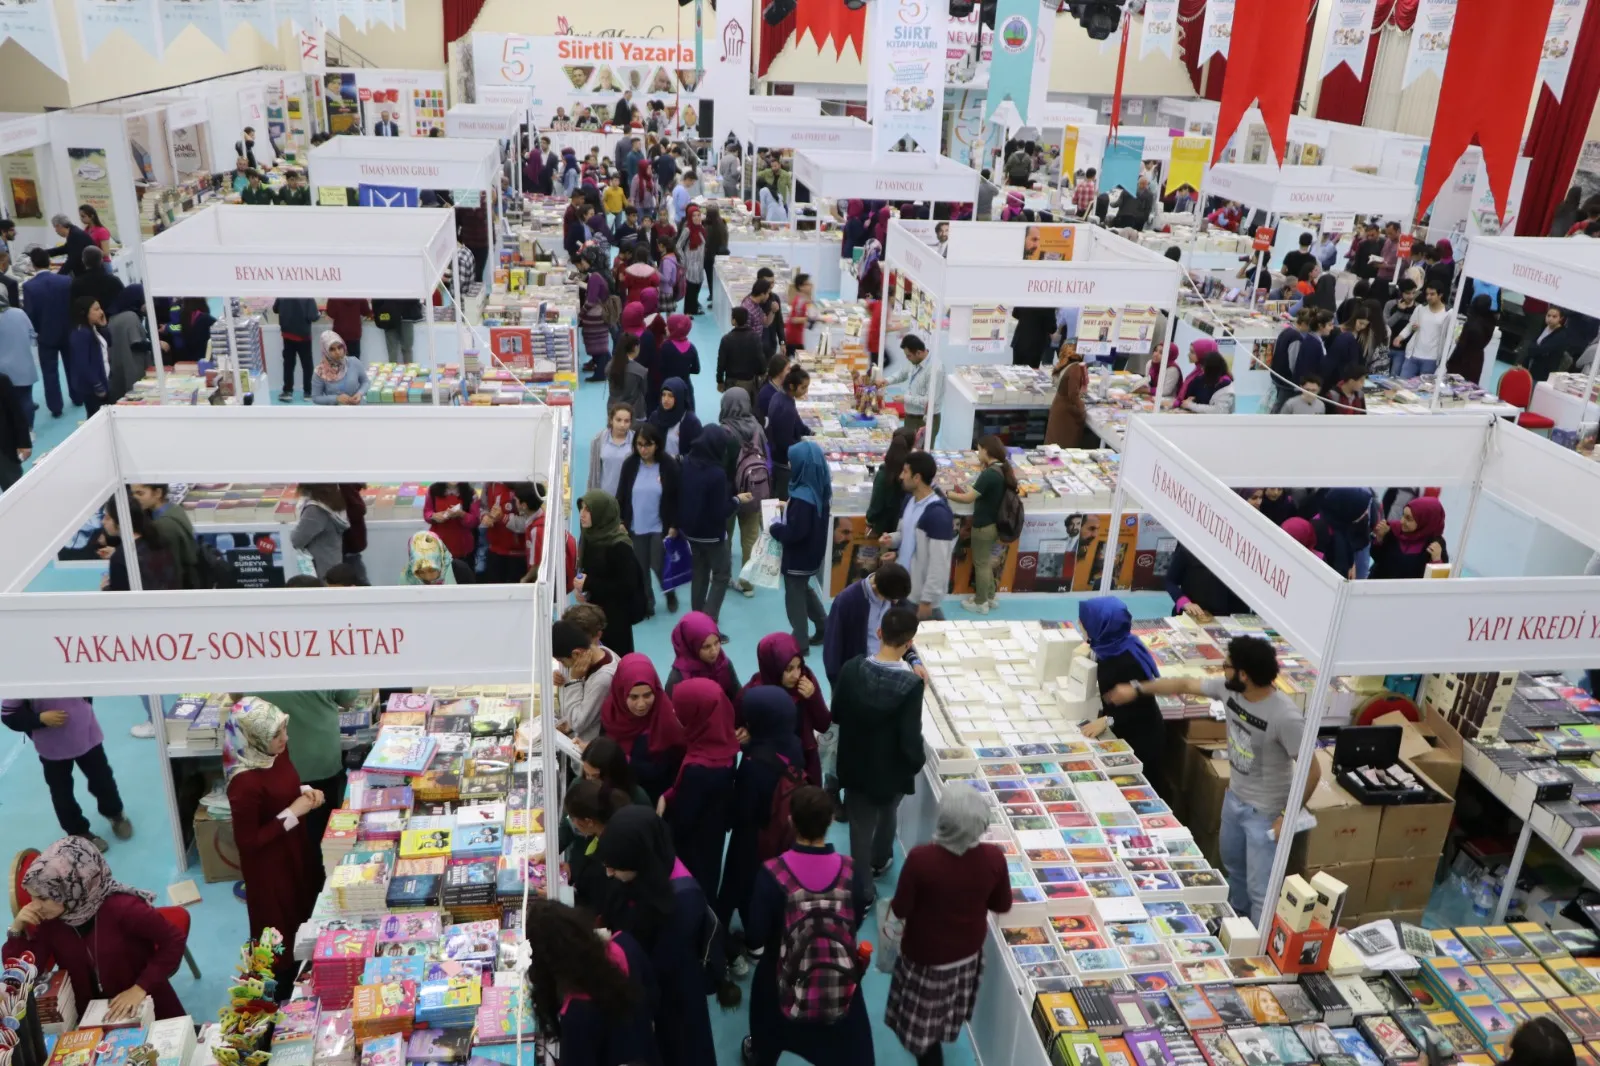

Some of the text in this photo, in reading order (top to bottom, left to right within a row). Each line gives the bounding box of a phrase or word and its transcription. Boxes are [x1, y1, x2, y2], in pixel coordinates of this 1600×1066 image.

[558, 40, 614, 60] Siirtli
[360, 164, 440, 177] TİMAŞ YAYIN GRUBU
[235, 266, 342, 281] BEYAN YAYINLARI
[1027, 277, 1096, 294] PROFİL KİTAP
[1512, 262, 1562, 291] YEDİTEPE-ATAÇ
[1152, 459, 1291, 599] İŞ BANKASI KÜLTÜR YAYINLARI
[1466, 615, 1514, 641] YAPI
[1517, 609, 1586, 640] KREDİ
[54, 623, 405, 663] YAKAMOZ-SONSUZ KİTAP
